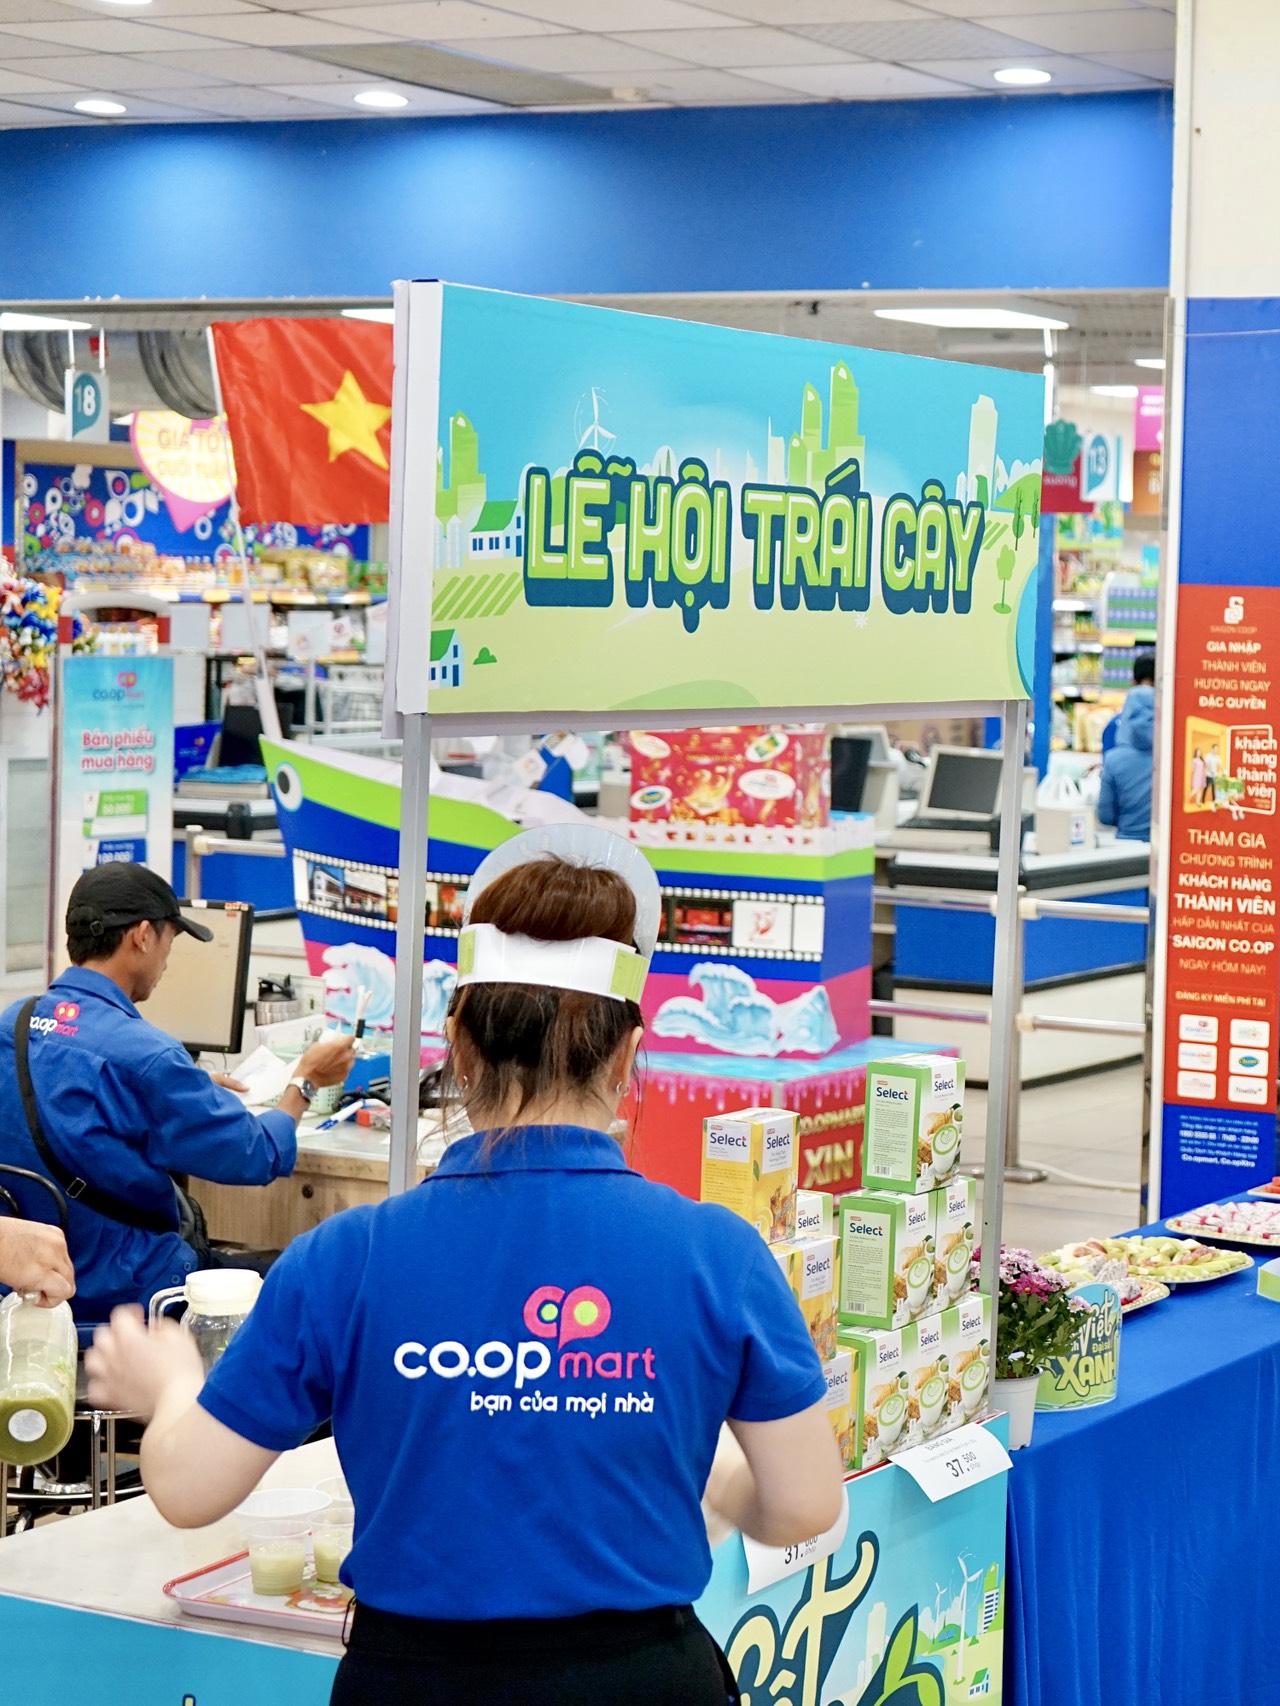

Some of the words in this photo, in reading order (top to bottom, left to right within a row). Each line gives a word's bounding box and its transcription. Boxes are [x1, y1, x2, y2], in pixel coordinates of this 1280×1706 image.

[75, 384, 96, 417] 18
[525, 450, 634, 601] LỄ
[626, 460, 729, 622] HỘI
[742, 460, 870, 602] TRÁI
[883, 480, 984, 606] CÂY
[1206, 641, 1227, 652] GIA
[1228, 640, 1262, 655] NHẬP
[1202, 658, 1239, 672] THÀNH
[1241, 660, 1267, 673] VIÊN
[1240, 680, 1271, 692] NGAY
[1199, 694, 1224, 709] ĐẶC
[1225, 695, 1267, 710] QUYỀN
[82, 731, 110, 748] Bán
[114, 728, 154, 750] phiếu
[1235, 736, 1278, 750] khách
[82, 755, 113, 770] mua
[117, 750, 154, 773] hàng
[1242, 751, 1278, 768] hàng
[1236, 767, 1277, 783] thành
[1246, 783, 1276, 798] viên
[1187, 828, 1234, 847] THAM
[1237, 832, 1267, 849] GIA
[1179, 852, 1235, 867] CHƯƠNG
[1237, 855, 1273, 869] TRÌNH
[1178, 871, 1228, 889] KHÁCH
[1231, 874, 1272, 892] HÀNG
[1174, 891, 1233, 912] THÀNH
[1236, 895, 1276, 916] VIÊN
[1172, 915, 1195, 927] HẤP
[1196, 916, 1220, 930] DẪN
[1221, 918, 1250, 931] NHẤT
[1251, 921, 1275, 934] CỦA
[1172, 934, 1226, 951] SAIGON
[1228, 938, 1274, 955] CO.OP
[1179, 958, 1210, 970] NGAY
[1211, 960, 1239, 973] HÔM
[1241, 962, 1266, 975] NAY!
[935, 1079, 954, 1091] Select
[877, 1087, 908, 1100] Select
[710, 1133, 747, 1147] Select
[767, 1134, 790, 1149] Select
[803, 1139, 854, 1189] XIN
[949, 1200, 965, 1212] Select
[798, 1214, 820, 1228] Select
[909, 1212, 926, 1225] Select
[850, 1223, 883, 1236] Select
[806, 1258, 830, 1276] Select
[962, 1316, 981, 1330] Select
[920, 1331, 940, 1346] Select
[879, 1348, 899, 1363] Select
[470, 1391, 512, 1416] bạn
[520, 1390, 557, 1412] của
[566, 1392, 606, 1419] mọi
[615, 1392, 654, 1413] nhà
